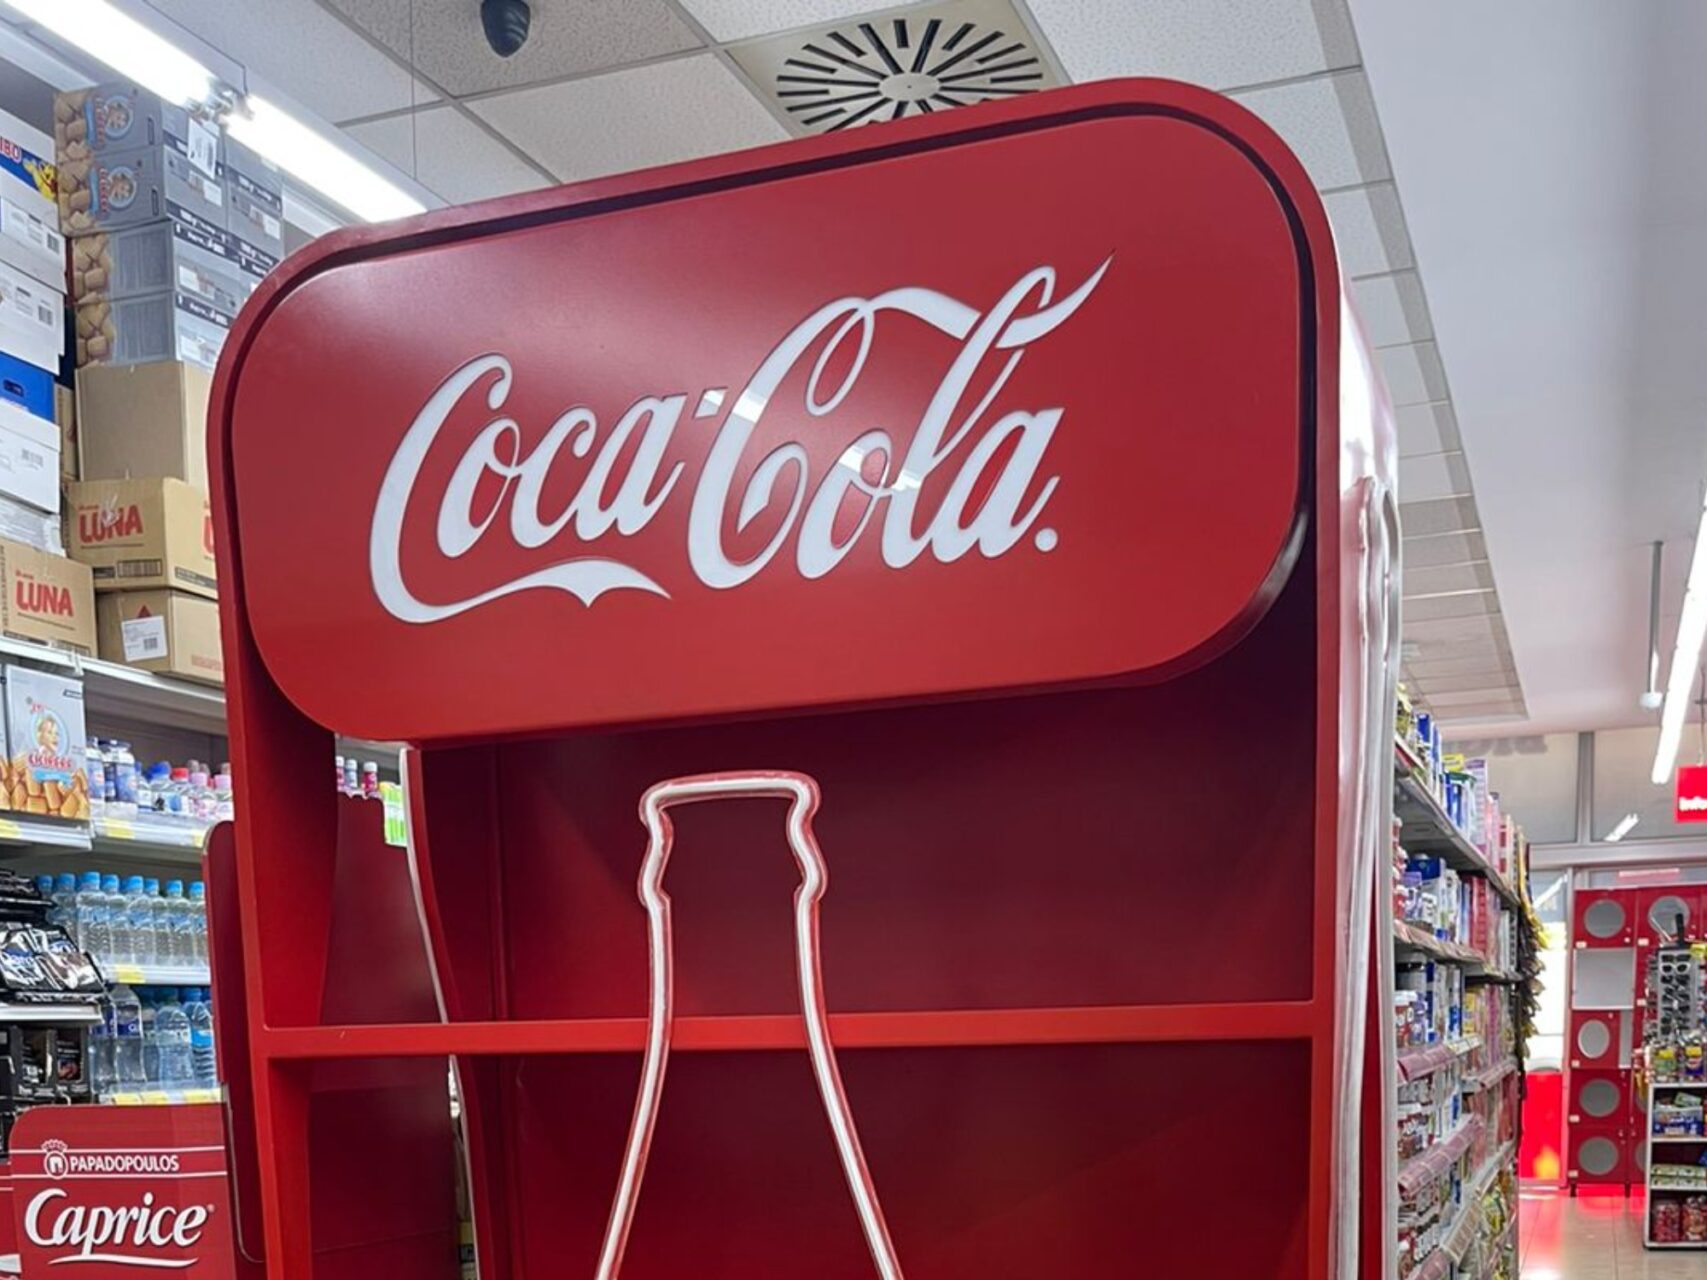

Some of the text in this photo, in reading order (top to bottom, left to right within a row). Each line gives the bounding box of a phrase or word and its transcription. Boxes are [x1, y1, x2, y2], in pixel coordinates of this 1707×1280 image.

[78, 504, 143, 544] LUNA
[16, 580, 74, 617] LUNA
[70, 1154, 179, 1172] PAPADOPOULOS
[25, 1188, 208, 1257] Caprice
